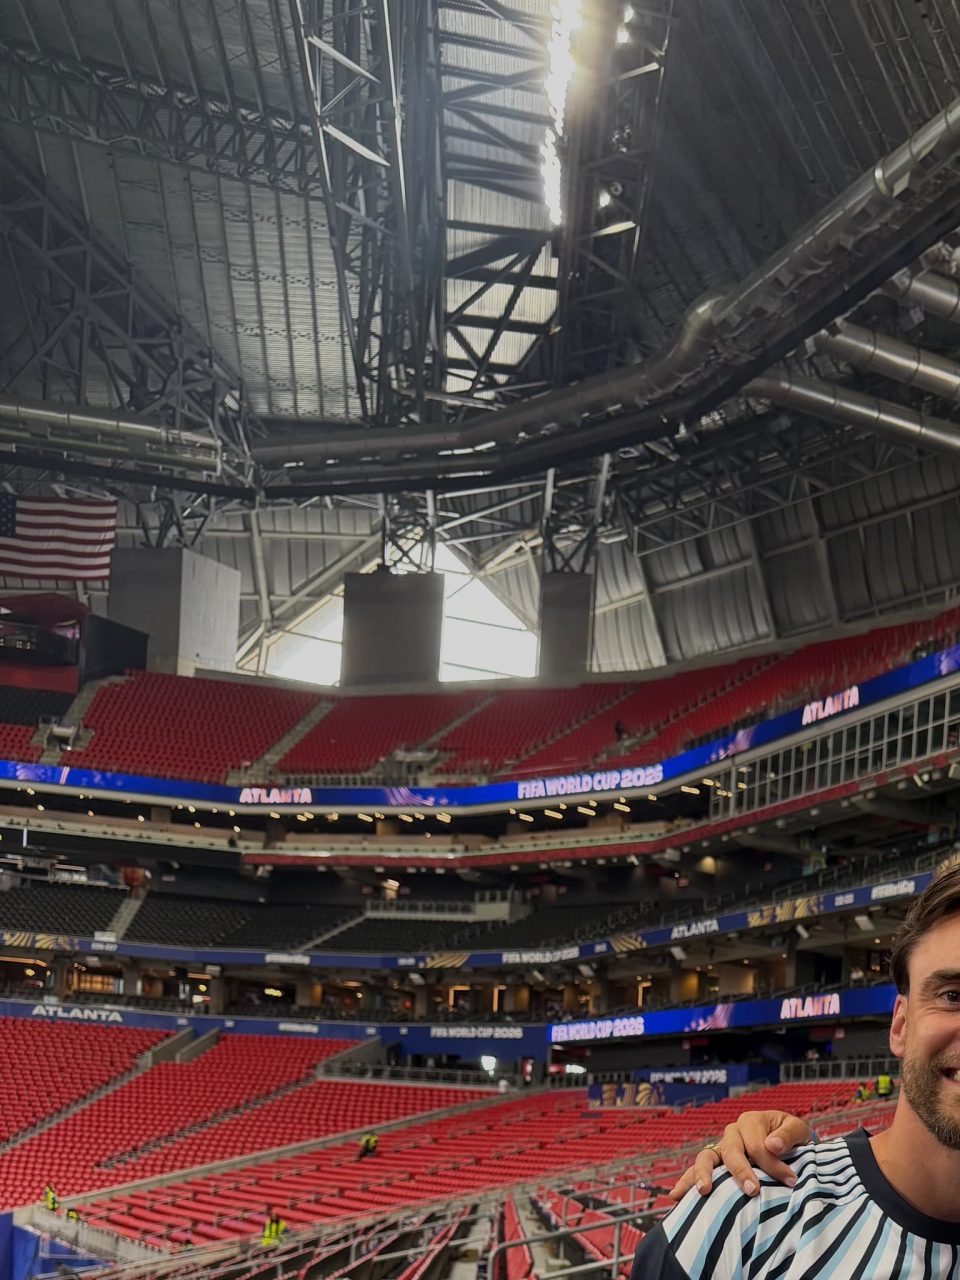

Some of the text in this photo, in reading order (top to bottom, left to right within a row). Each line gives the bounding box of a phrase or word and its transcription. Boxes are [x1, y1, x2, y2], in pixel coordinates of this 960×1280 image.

[802, 686, 859, 725] ATLANTA
[518, 763, 663, 799] FIFA WORLD CUP 2026
[239, 787, 312, 804] ATLANTA
[670, 919, 719, 940] ATLANTA
[32, 1004, 123, 1023] ATLANTA
[781, 994, 840, 1019] ATLANTA
